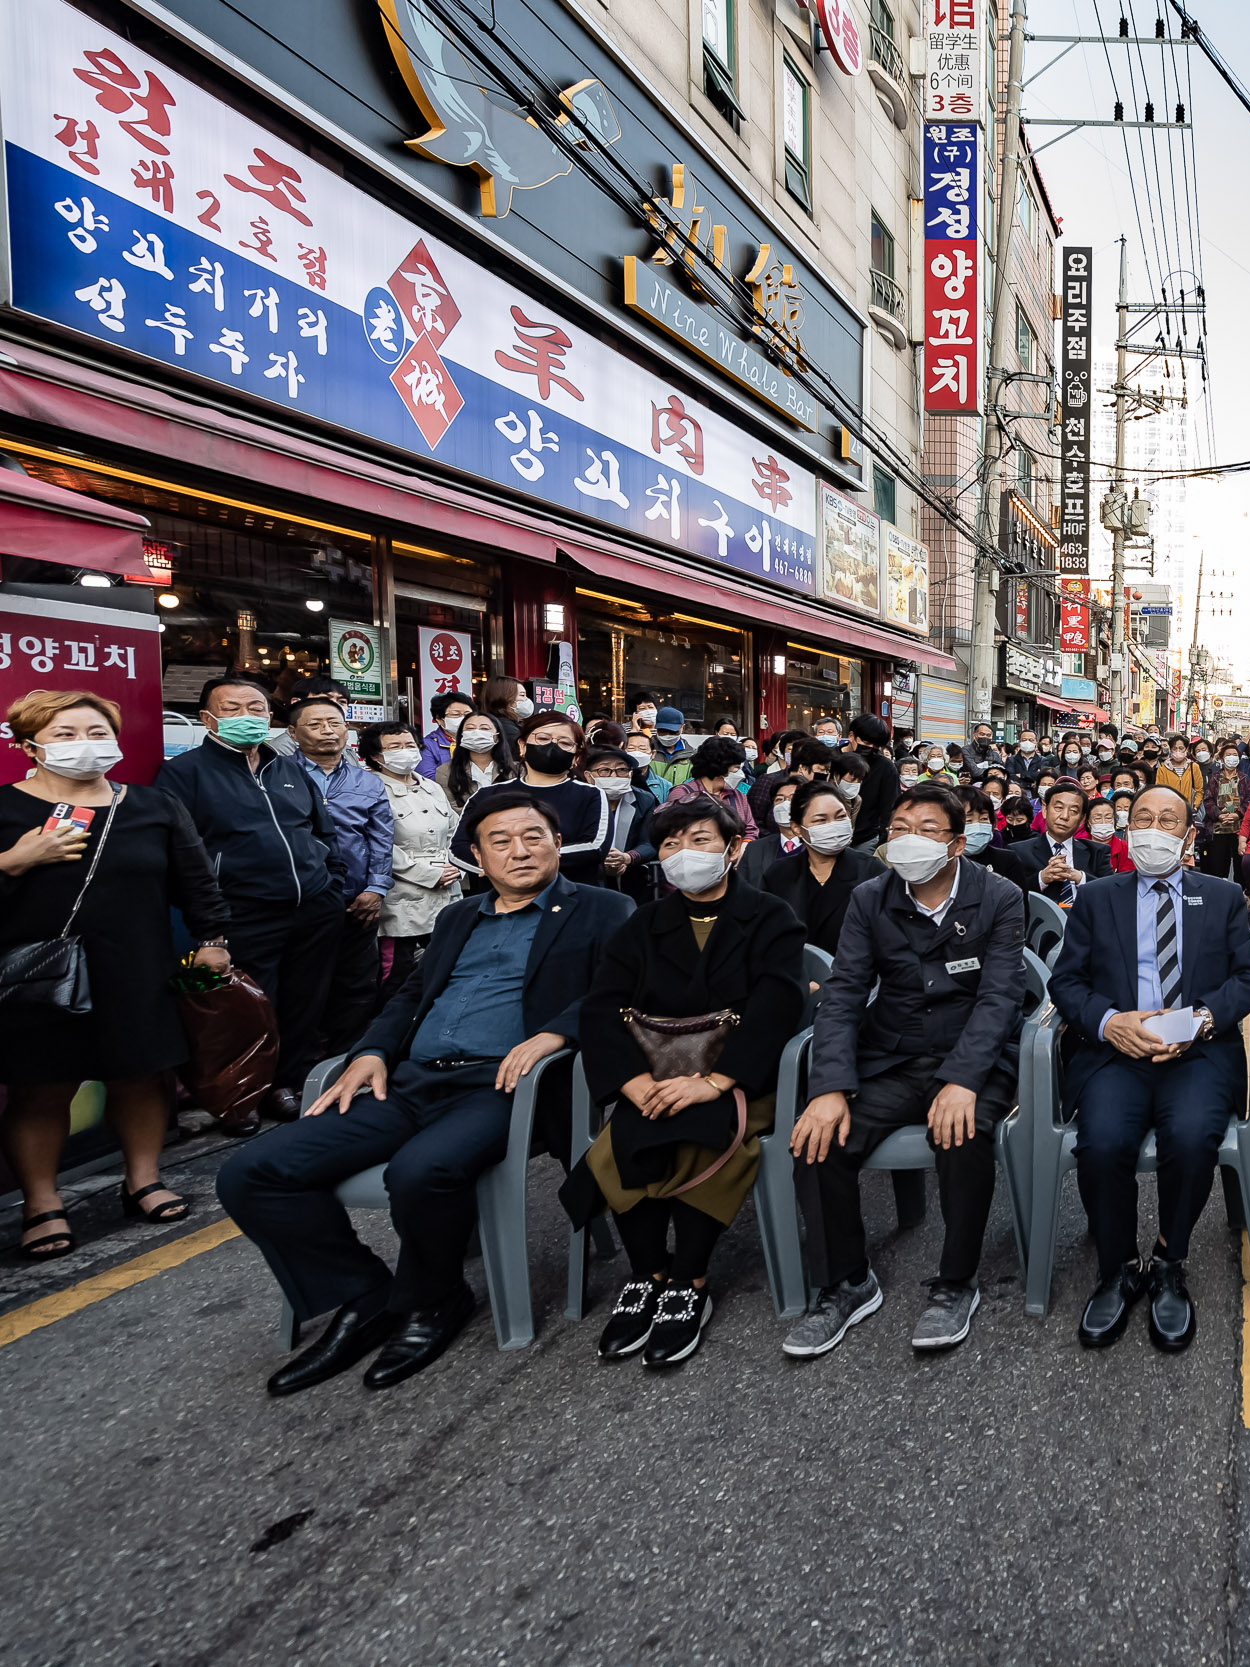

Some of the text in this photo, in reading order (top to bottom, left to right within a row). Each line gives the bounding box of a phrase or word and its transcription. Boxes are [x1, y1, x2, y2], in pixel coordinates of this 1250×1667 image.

[929, 32, 978, 51] 留学生
[937, 53, 970, 71] 优惠
[932, 93, 974, 114] 3층
[72, 48, 314, 228] 원조
[925, 125, 976, 144] 원조
[1066, 252, 1089, 361] 요리주점
[928, 249, 974, 404] 양꼬치
[650, 280, 815, 422] Nine Whale Bar
[494, 305, 794, 514] 羊肉串
[1063, 522, 1087, 536] HOF
[1061, 543, 1088, 555] 463-
[774, 557, 812, 585] 467-6880
[1060, 557, 1087, 569] 1833
[432, 642, 459, 662] 원조
